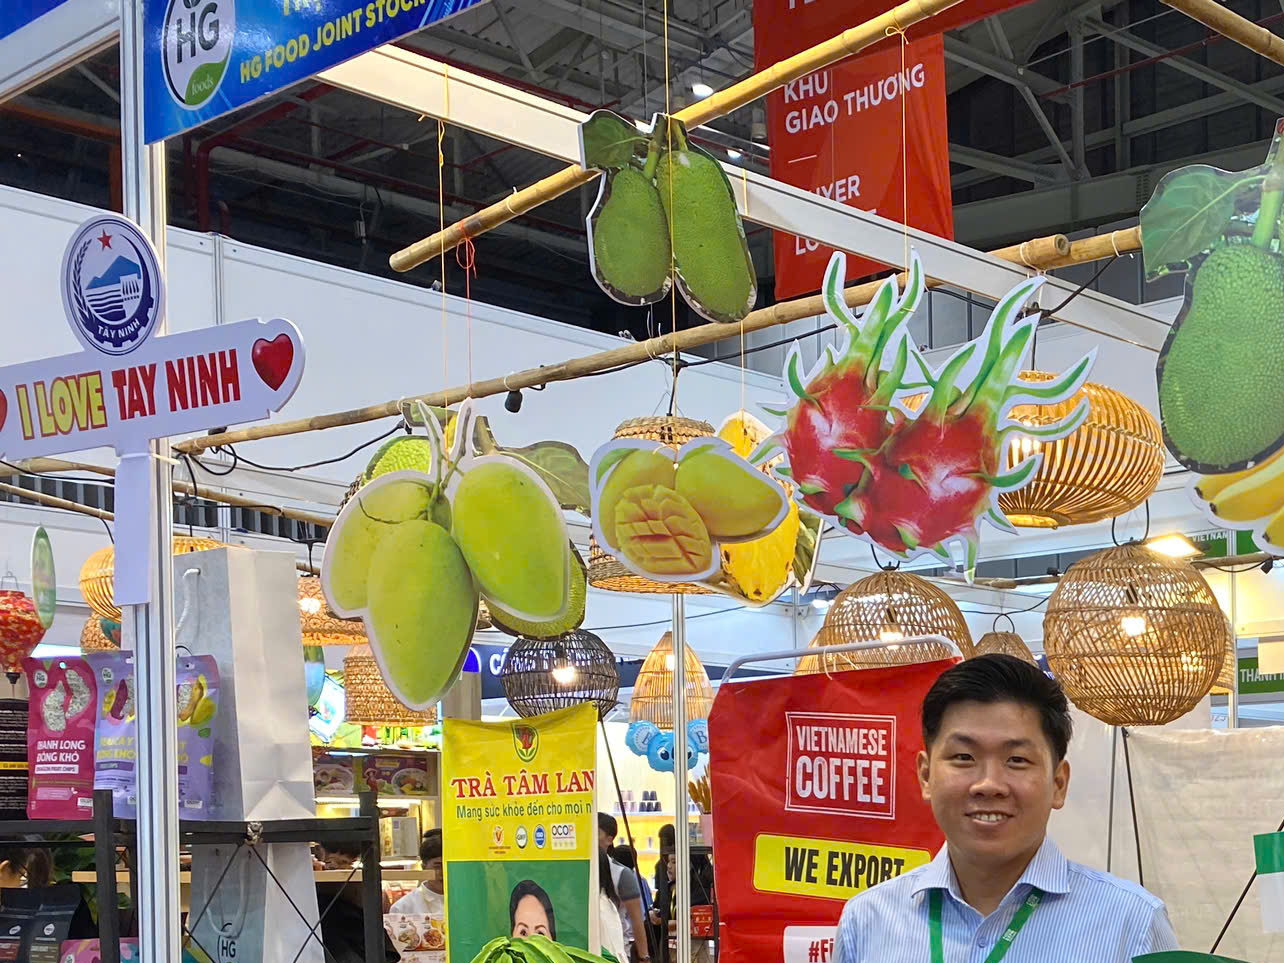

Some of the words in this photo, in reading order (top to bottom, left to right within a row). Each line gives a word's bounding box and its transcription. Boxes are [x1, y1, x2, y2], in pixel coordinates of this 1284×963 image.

[176, 3, 220, 64] HG
[240, 59, 262, 84] HG
[264, 40, 310, 72] FOOD
[312, 12, 361, 51] JOINT
[190, 74, 214, 95] foods
[784, 71, 828, 103] KHU
[785, 99, 838, 133] GIAO
[844, 63, 925, 115] THƯƠNG
[15, 384, 34, 440] I
[35, 371, 108, 436] LOVE
[113, 365, 156, 420] TAY
[168, 348, 241, 411] NINH
[796, 725, 887, 756] VIETNAMESE
[796, 755, 886, 804] COFFEE
[456, 805, 483, 821] Mang
[547, 802, 562, 815] cho
[785, 846, 818, 883] WE
[826, 850, 905, 889] EXPORT
[221, 941, 236, 957] HG
